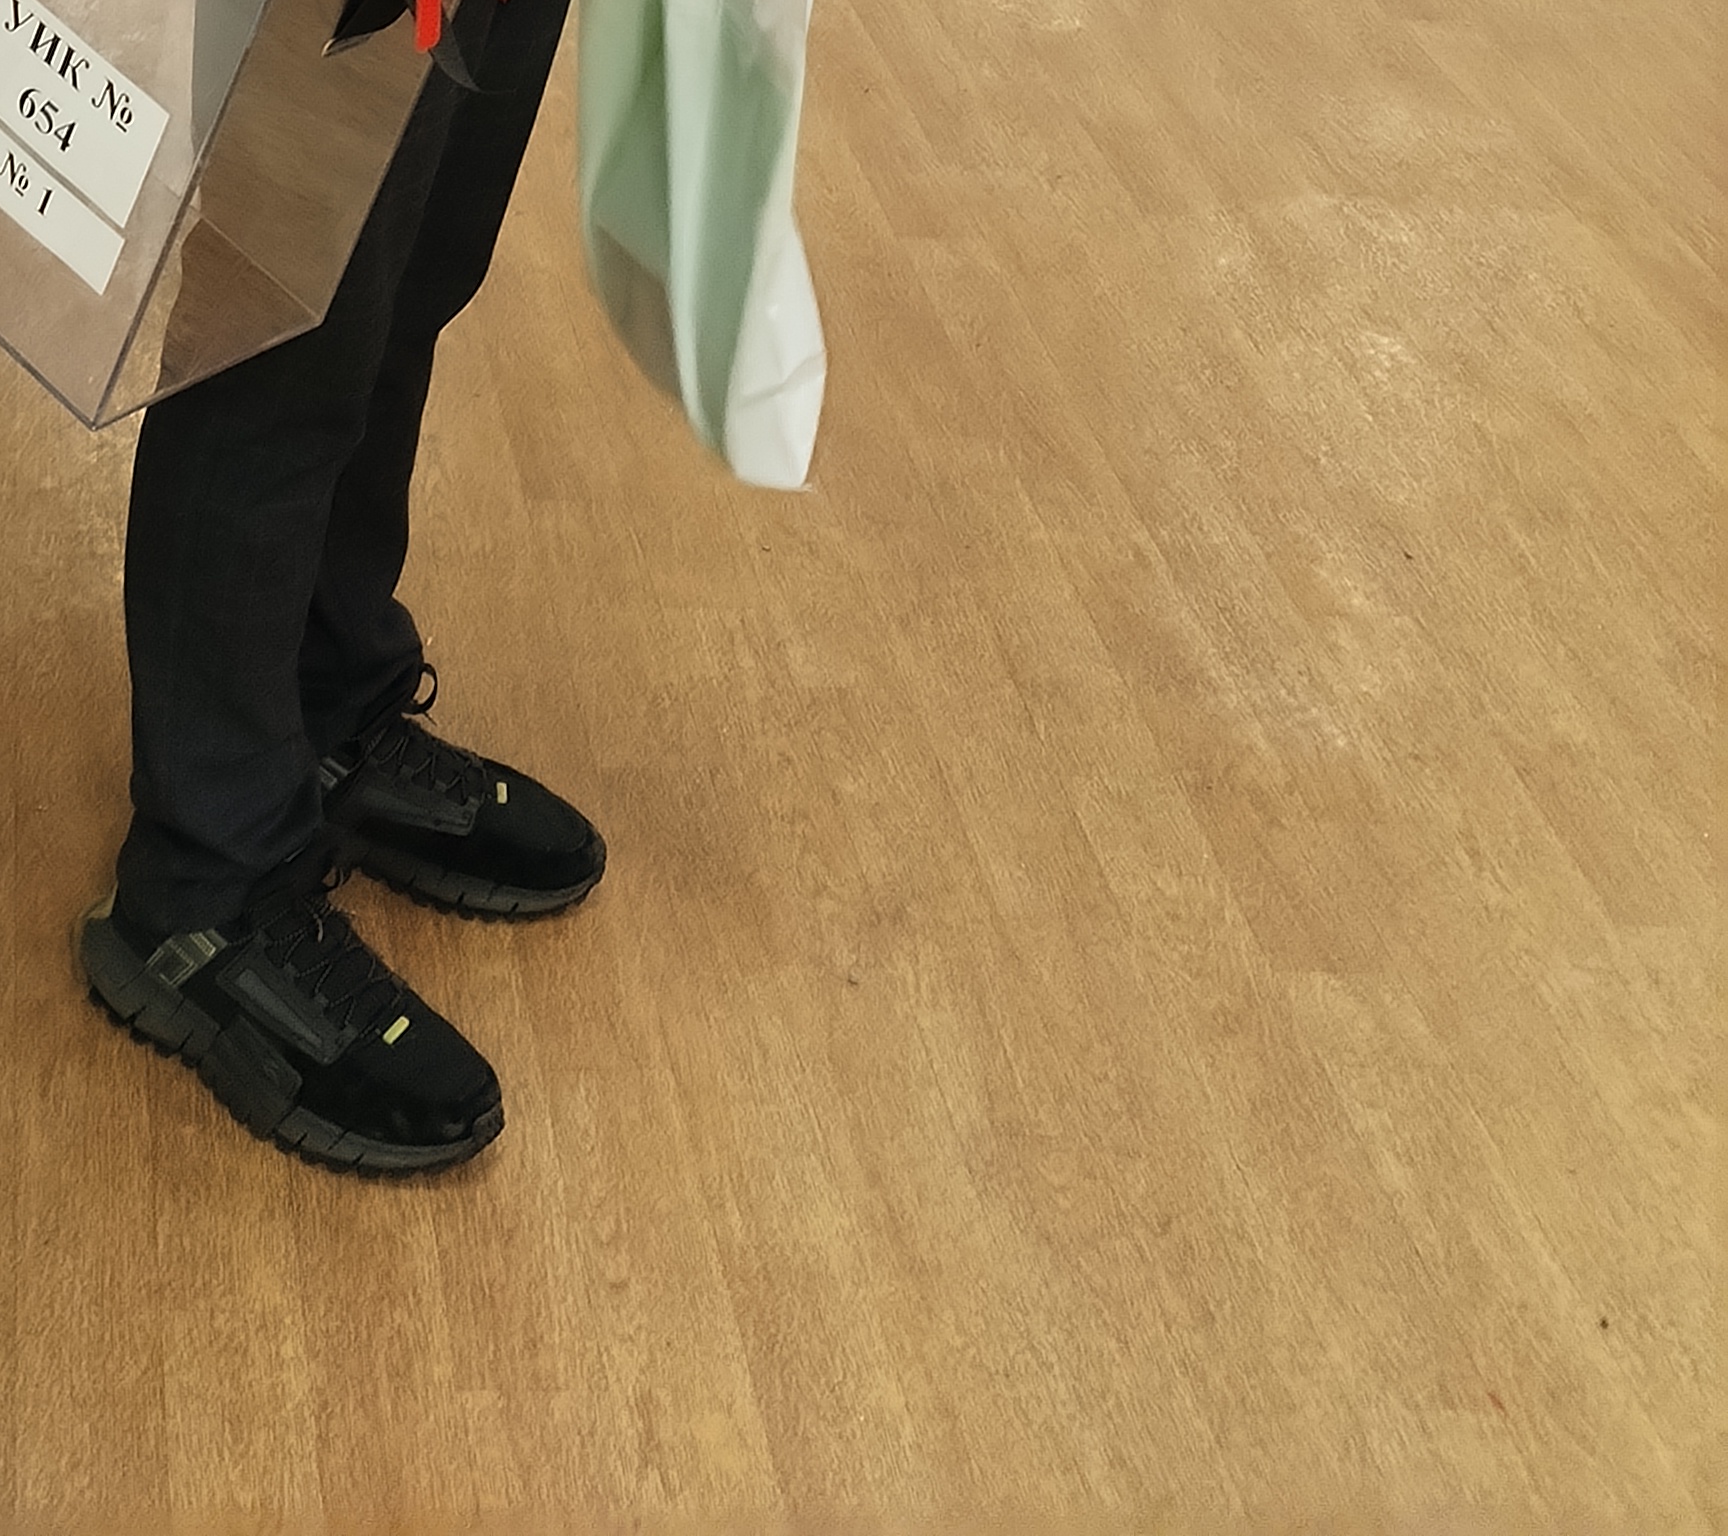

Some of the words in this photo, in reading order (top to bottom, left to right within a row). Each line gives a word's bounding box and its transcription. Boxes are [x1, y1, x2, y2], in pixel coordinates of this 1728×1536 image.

[18, 86, 77, 153] 654
[91, 77, 133, 134] №
[37, 186, 54, 216] 1
